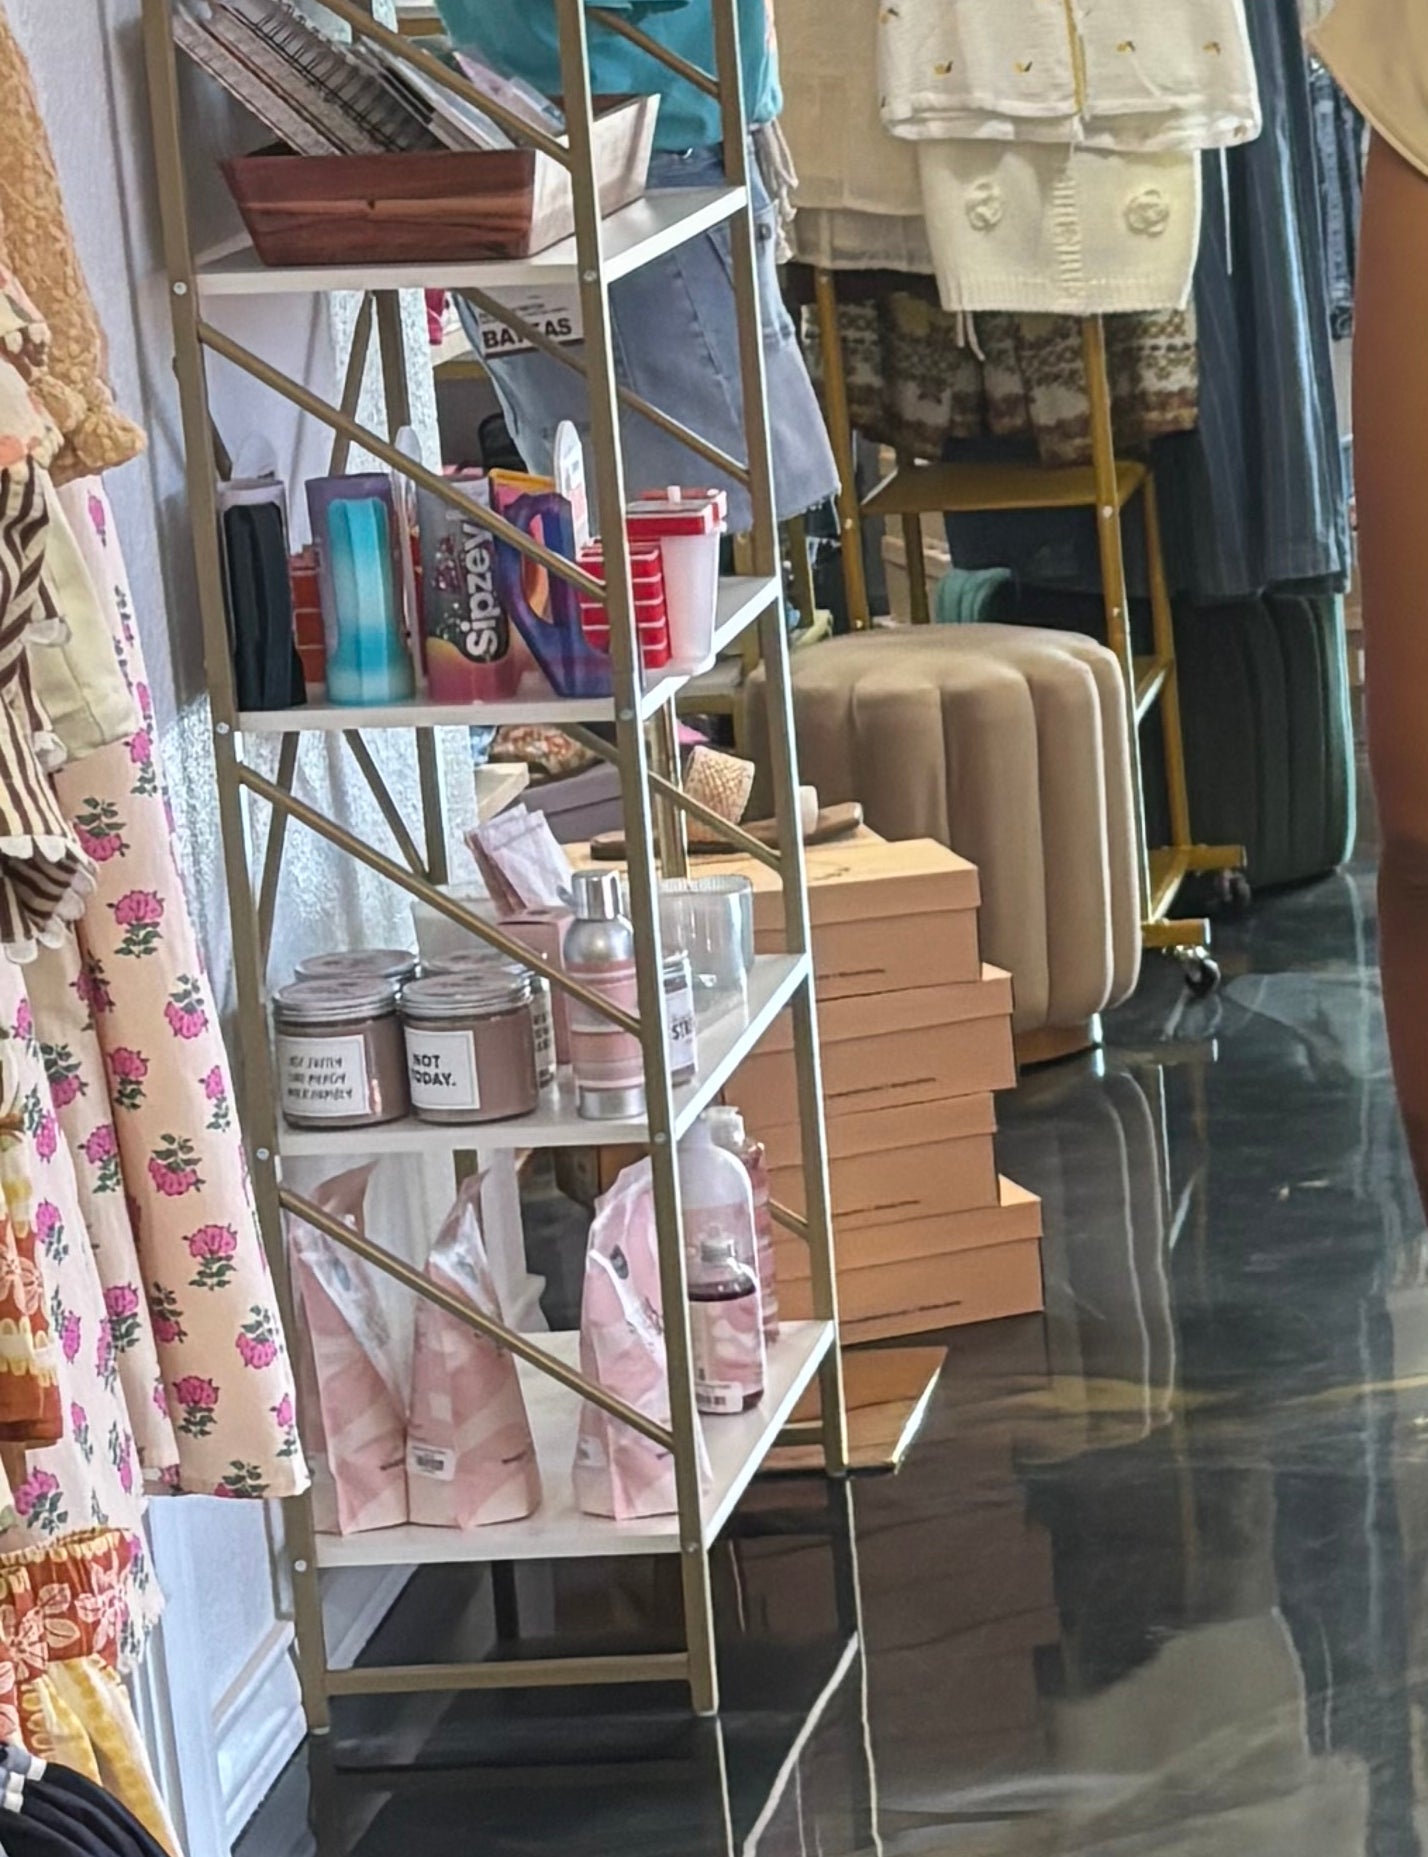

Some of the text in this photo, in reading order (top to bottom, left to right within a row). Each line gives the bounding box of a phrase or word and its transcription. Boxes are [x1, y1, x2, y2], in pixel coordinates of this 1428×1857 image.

[481, 317, 573, 350] BAAS
[460, 522, 501, 658] Sipzey
[412, 1054, 441, 1069] NOT
